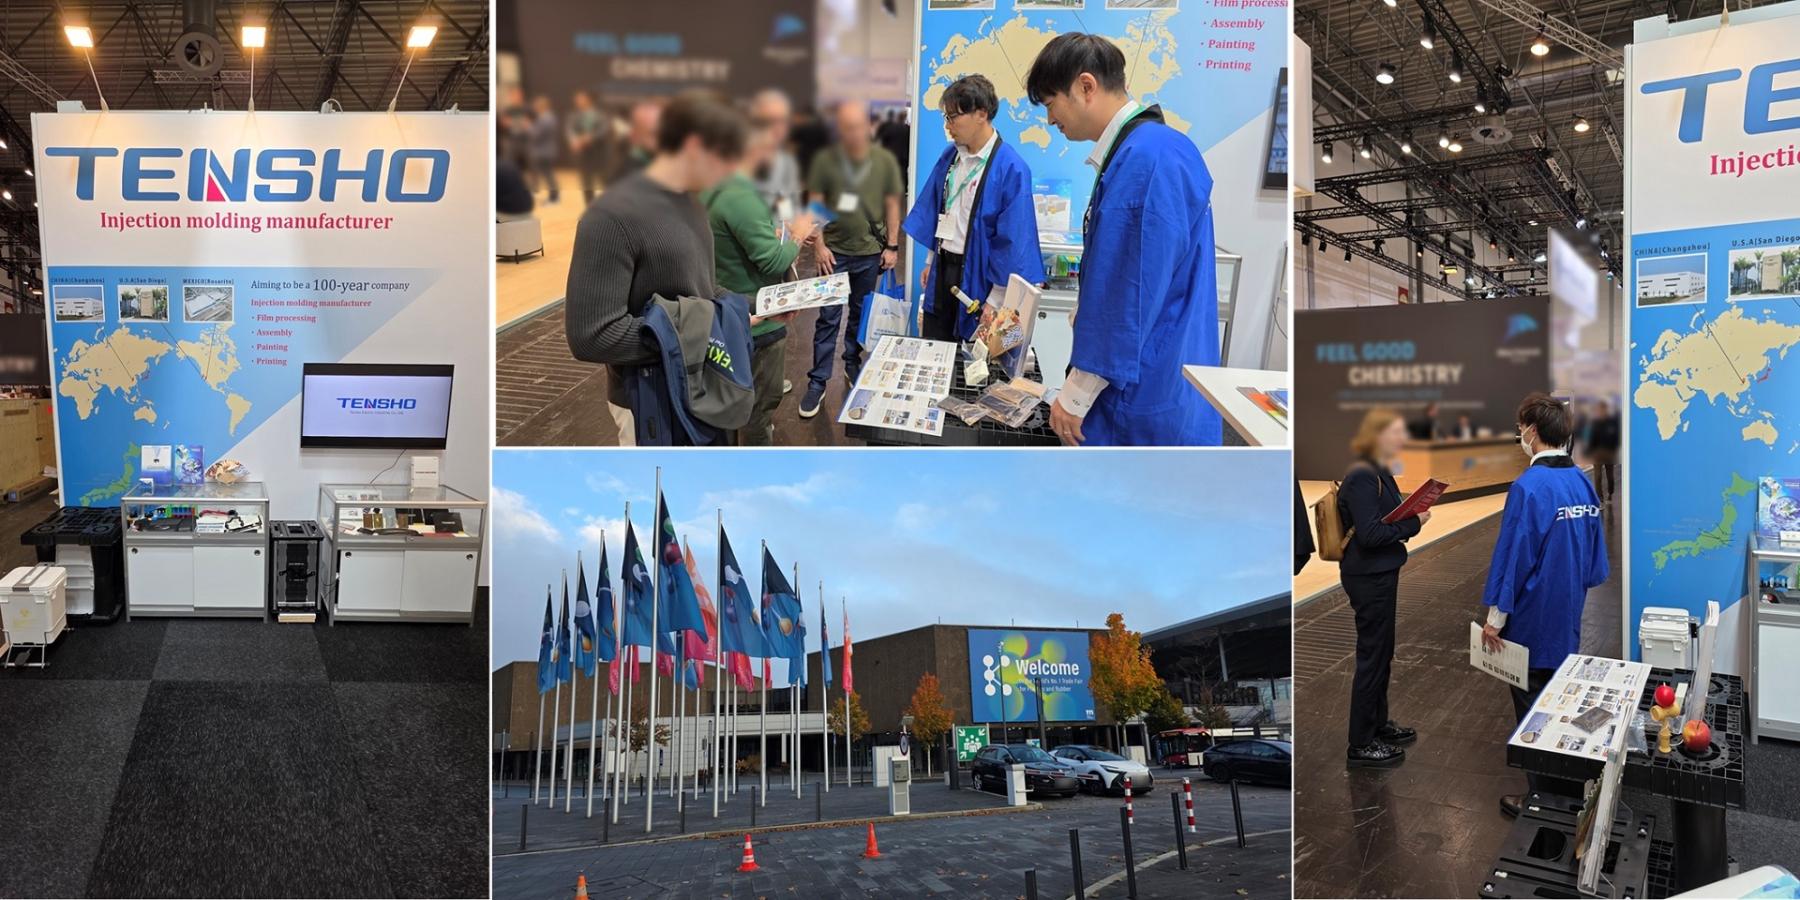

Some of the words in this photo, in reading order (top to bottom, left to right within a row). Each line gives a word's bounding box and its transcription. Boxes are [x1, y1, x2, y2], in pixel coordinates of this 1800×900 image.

[1210, 18, 1265, 31] Assembly
[1208, 39, 1255, 52] Painting
[1205, 60, 1252, 72] Printing
[1709, 144, 1800, 178] Injecti
[45, 147, 450, 203] TENSHO
[100, 211, 181, 233] Injection
[187, 211, 262, 234] molding
[267, 212, 394, 230] manufacturer
[250, 280, 281, 290] Aiming
[283, 281, 292, 289] to
[293, 280, 304, 289] be
[312, 279, 370, 293] 100-year
[371, 282, 410, 292] company
[250, 299, 285, 307] Injection
[286, 299, 318, 308] molding
[319, 299, 372, 307] manufacturer
[256, 314, 274, 322] Film
[275, 314, 316, 323] processing
[256, 329, 293, 337] Assembly
[256, 344, 288, 352] Painting
[256, 358, 287, 366] Printing
[1348, 363, 1463, 385] CHEMISTRY
[336, 397, 417, 410] TENSHO
[1015, 659, 1080, 676] Welcome
